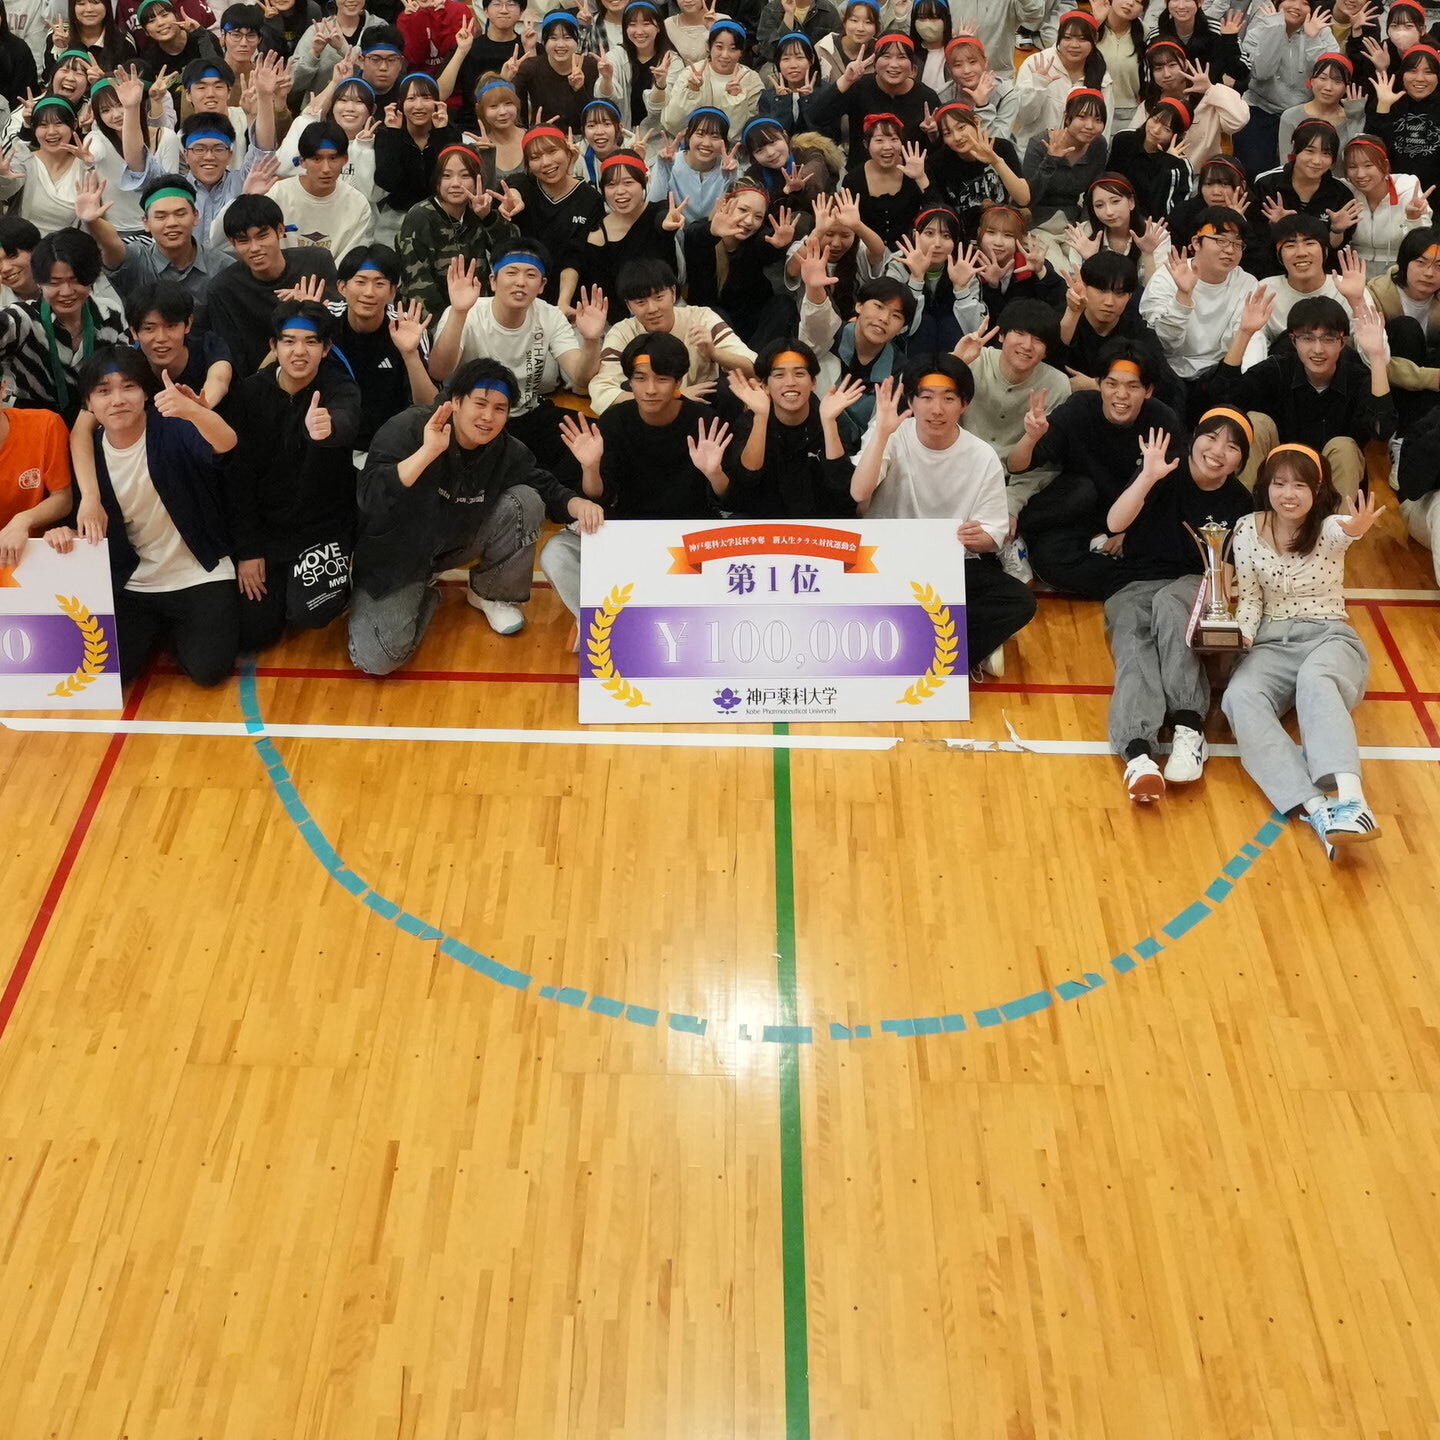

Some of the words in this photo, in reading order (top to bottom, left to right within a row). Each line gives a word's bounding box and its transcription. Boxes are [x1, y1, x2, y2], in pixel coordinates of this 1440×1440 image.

[293, 542, 342, 578] MOVE
[726, 563, 821, 596] 第1位
[746, 687, 838, 706] 神戸薬科大学
[809, 708, 837, 716] University
